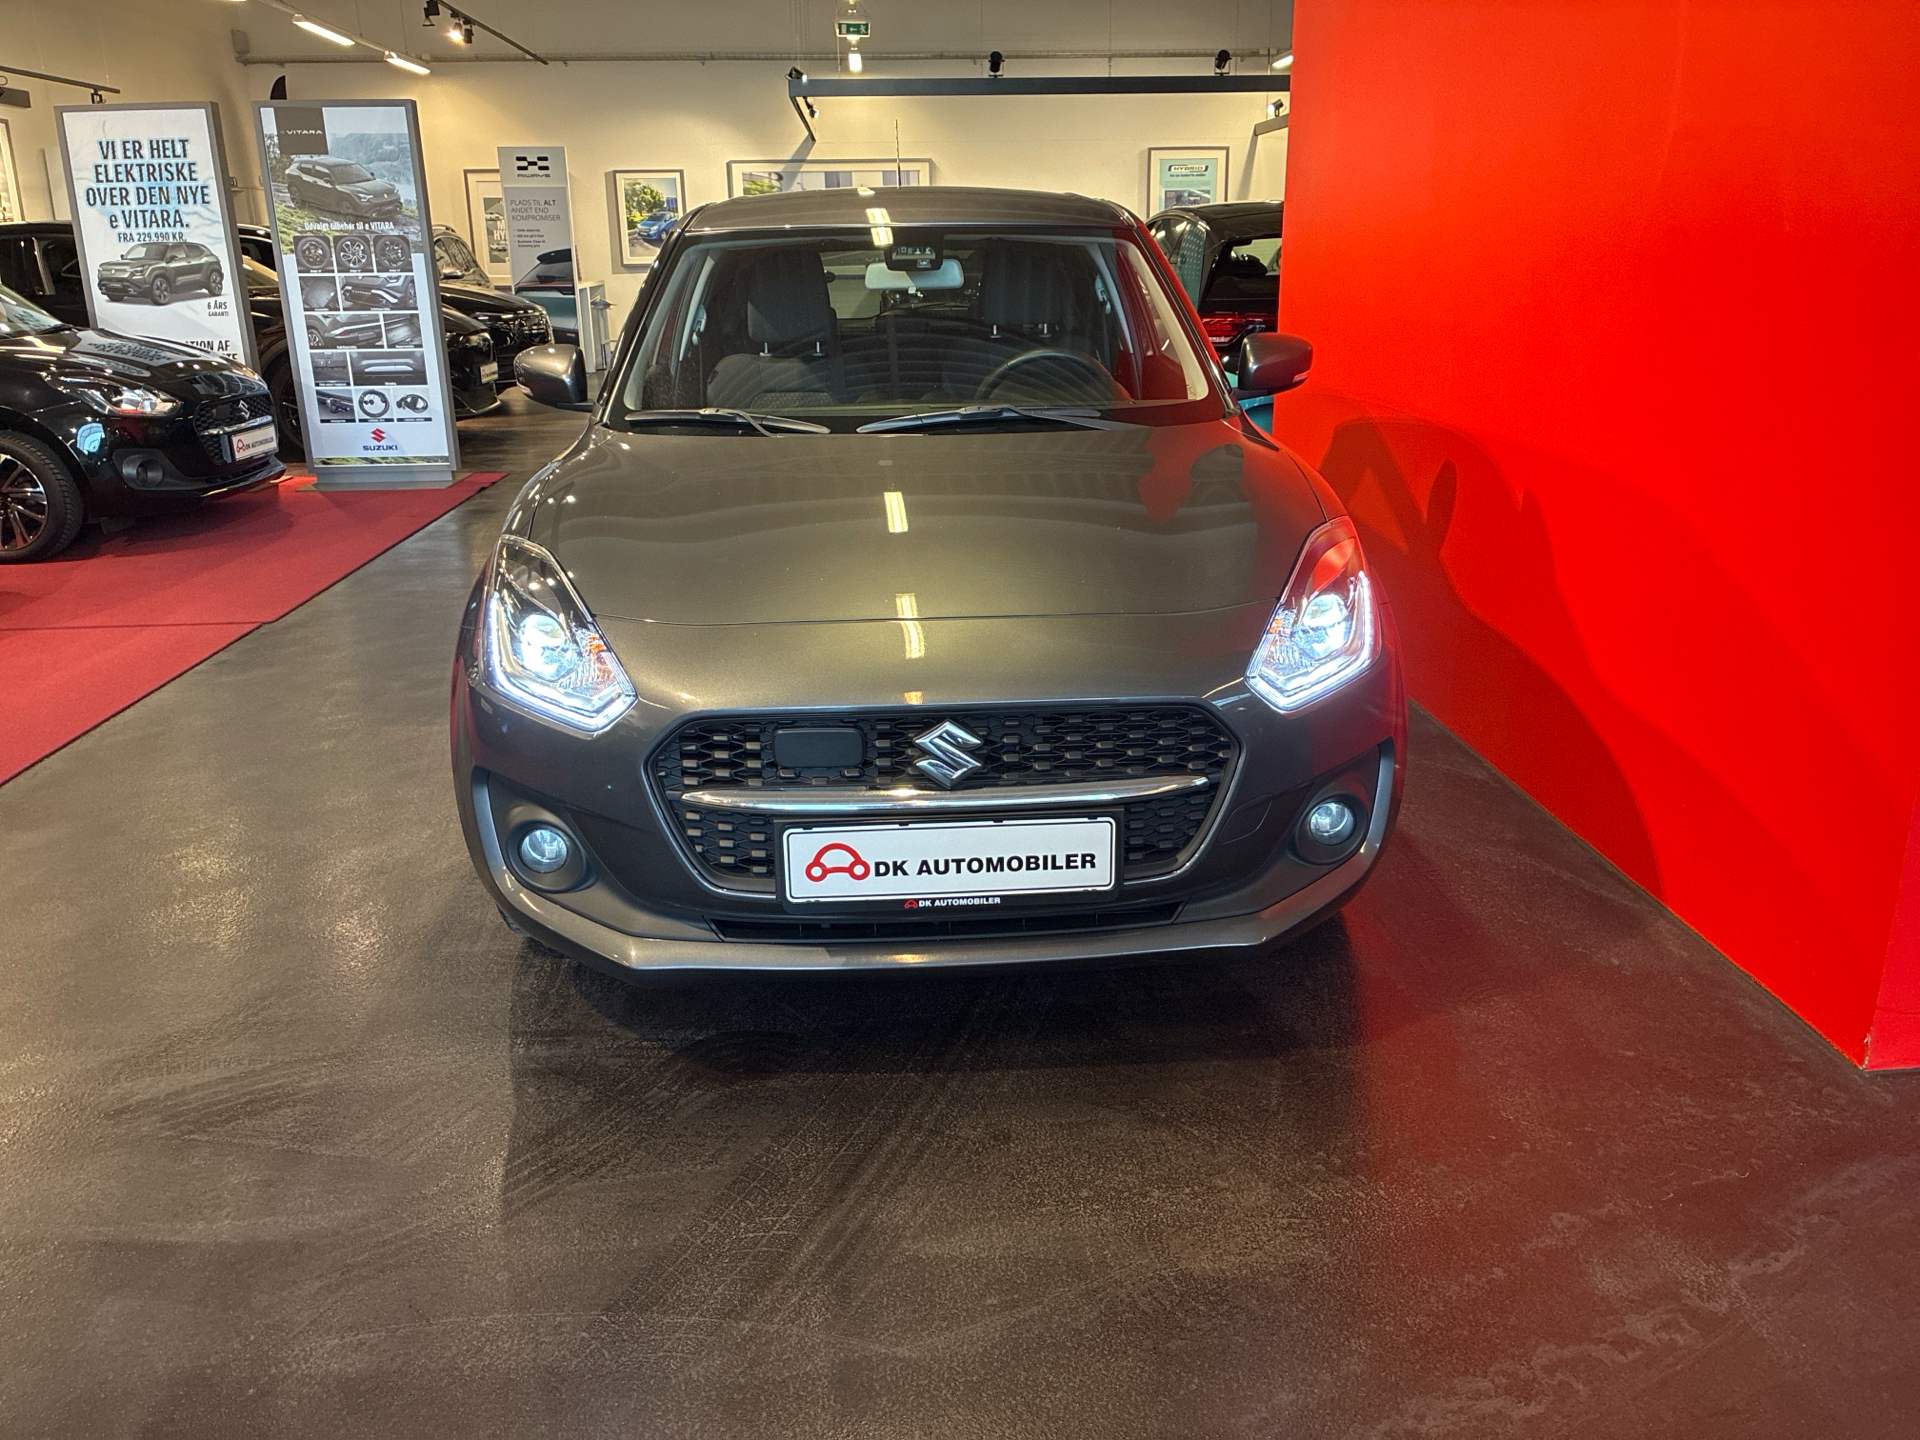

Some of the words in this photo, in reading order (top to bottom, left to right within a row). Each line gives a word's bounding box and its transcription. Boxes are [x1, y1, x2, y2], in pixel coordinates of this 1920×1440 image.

[99, 141, 116, 159] VI
[122, 140, 144, 159] ER
[149, 139, 189, 159] HELT
[94, 162, 198, 183] ELEKTRISKE
[86, 187, 131, 207] OVER
[136, 186, 171, 206] DEN
[176, 185, 210, 205] NYE
[109, 213, 118, 229] e
[121, 209, 190, 229] VITARA.
[304, 222, 329, 231] Udvalgt
[356, 222, 364, 230] til
[370, 221, 395, 230] VITARA
[118, 232, 135, 242] FRA
[136, 232, 170, 242] 229.990
[207, 302, 212, 310] 6
[213, 300, 228, 310] ÅRS
[217, 340, 231, 351] AF
[874, 860, 909, 877] DK
[916, 852, 1097, 876] AUTOMOBILER
[919, 899, 932, 908] DK
[934, 896, 1001, 907] AUTOMOBILER
